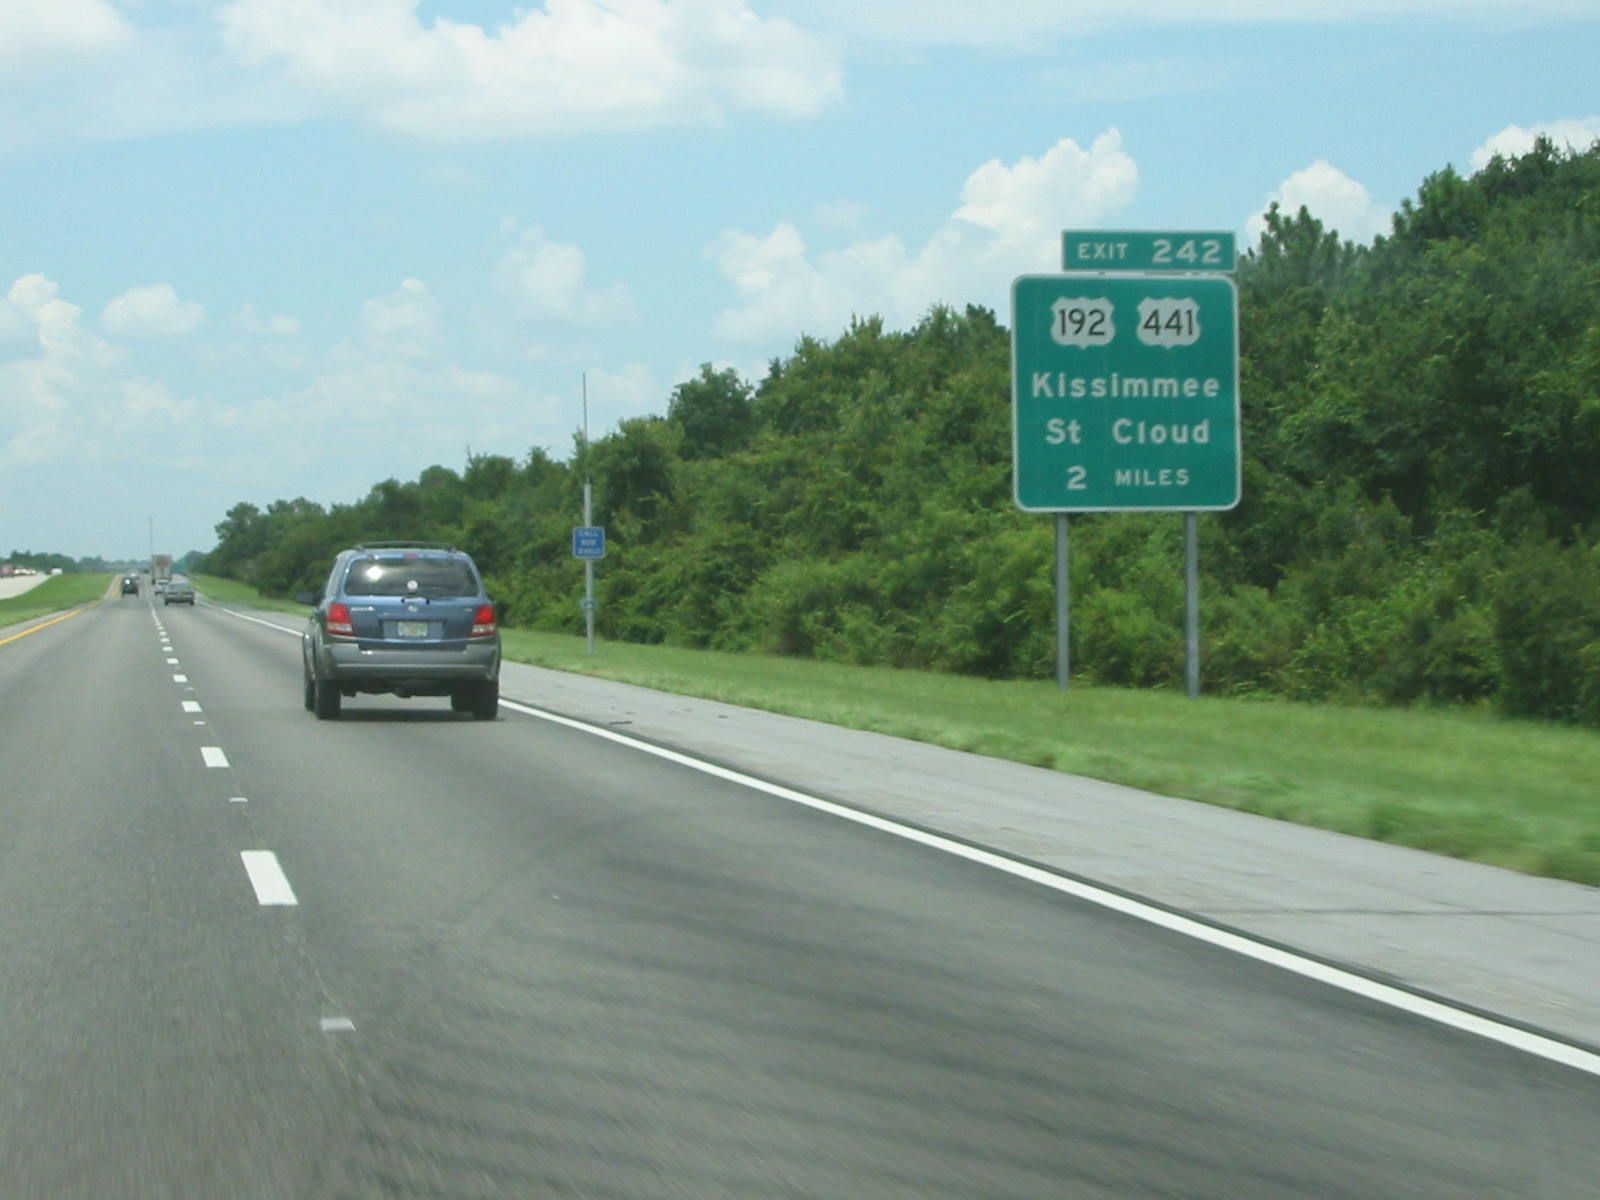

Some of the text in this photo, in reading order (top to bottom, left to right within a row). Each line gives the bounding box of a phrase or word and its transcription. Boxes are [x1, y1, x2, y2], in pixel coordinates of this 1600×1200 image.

[1077, 240, 1222, 264] EXIT 242
[1059, 308, 1194, 336] 192 441
[1032, 372, 1220, 398] Kissimmee
[1046, 418, 1210, 445] St Cloud
[1066, 466, 1190, 490] 2 MILES
